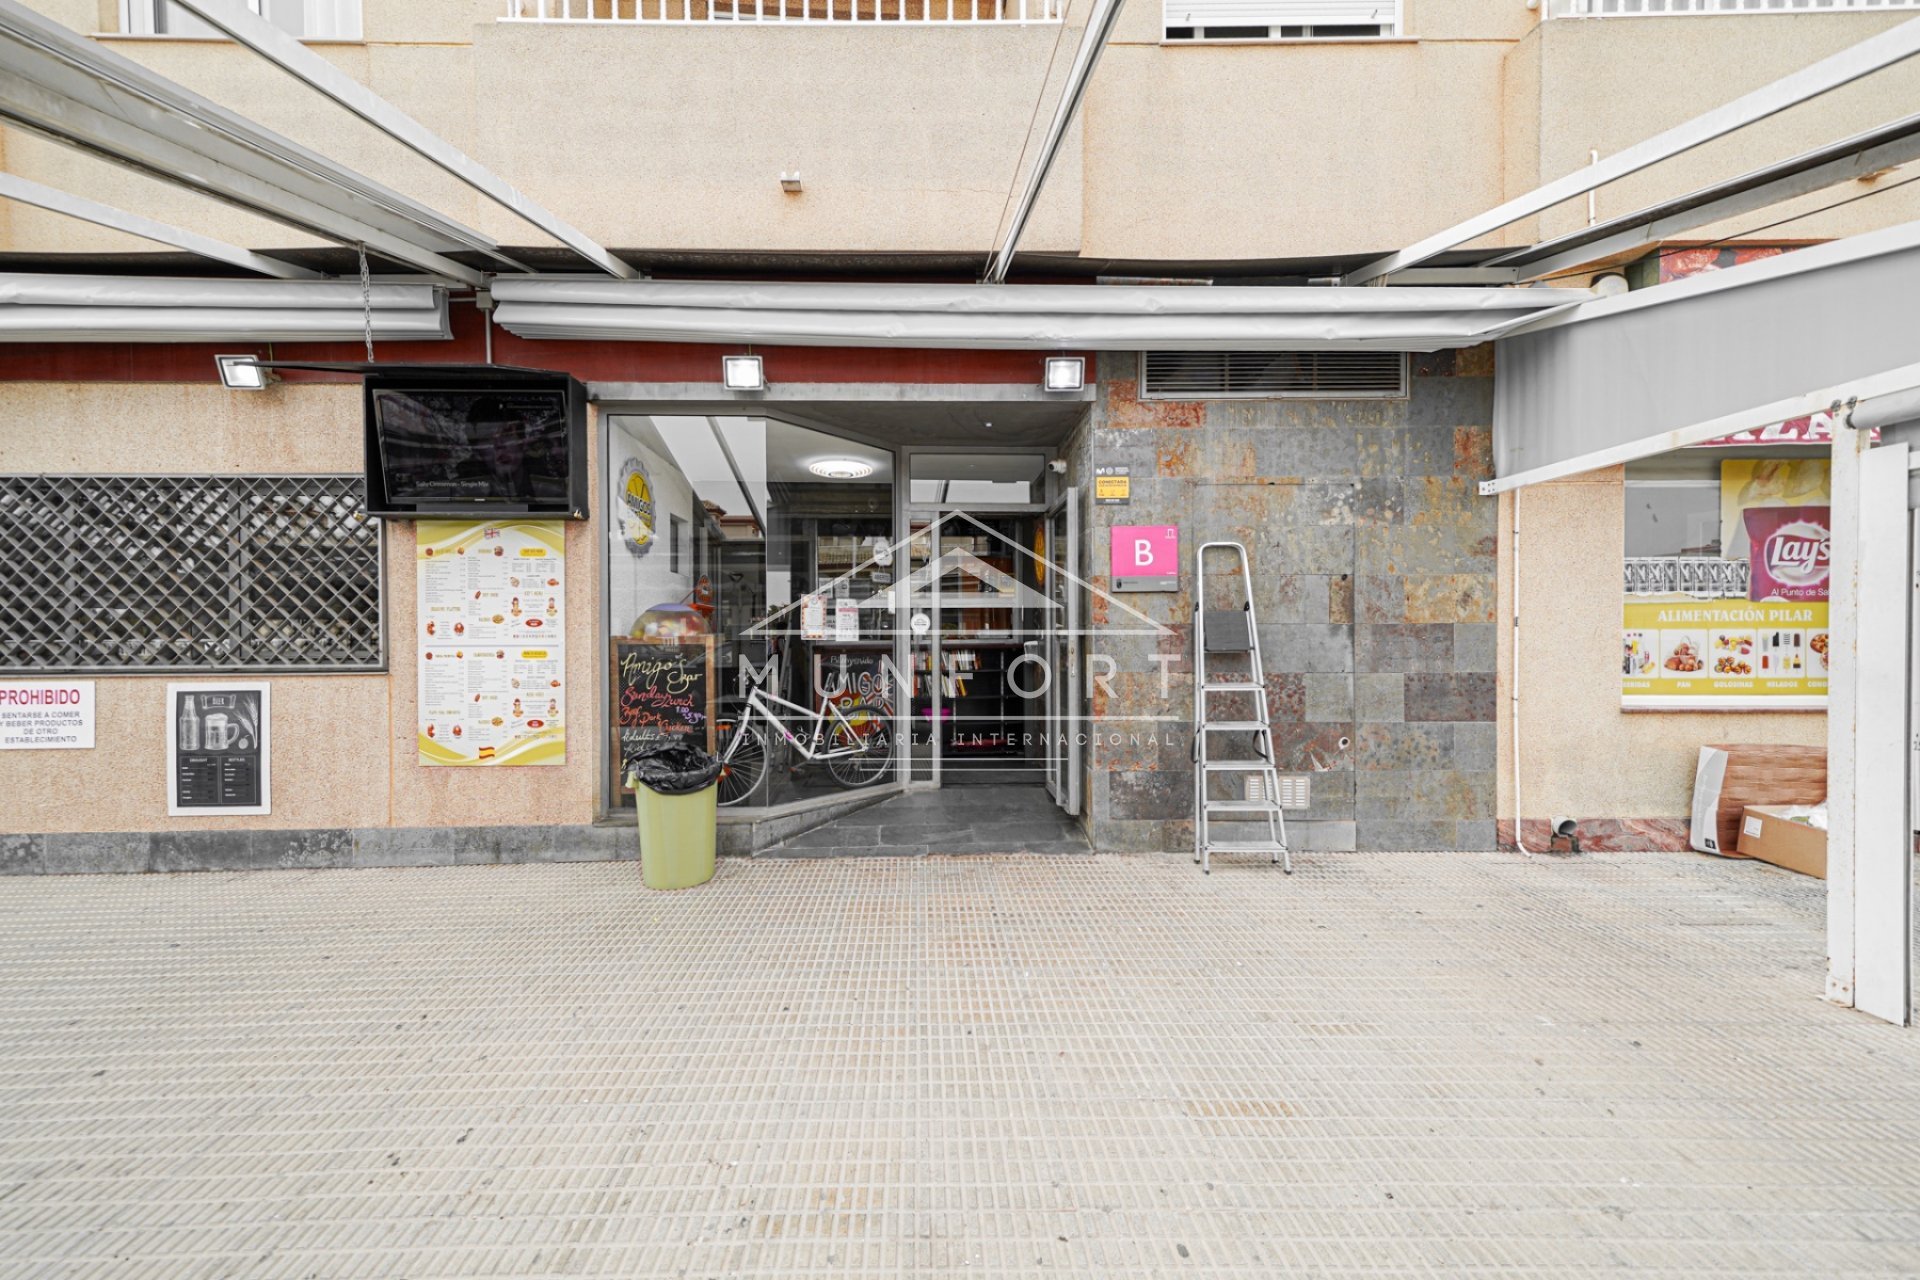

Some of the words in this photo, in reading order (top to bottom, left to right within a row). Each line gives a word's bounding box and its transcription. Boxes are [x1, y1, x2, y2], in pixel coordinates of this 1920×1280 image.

[1134, 539, 1154, 566] B
[1780, 588, 1803, 596] Punto
[1805, 588, 1816, 596] de
[1657, 606, 1765, 622] ALIMENTACIÓN
[1769, 609, 1813, 622] PILAR
[0, 689, 80, 705] PROHIBIDO
[1, 711, 42, 719] SENTARSE
[4, 735, 77, 744] ESTABLECIMIENTO
